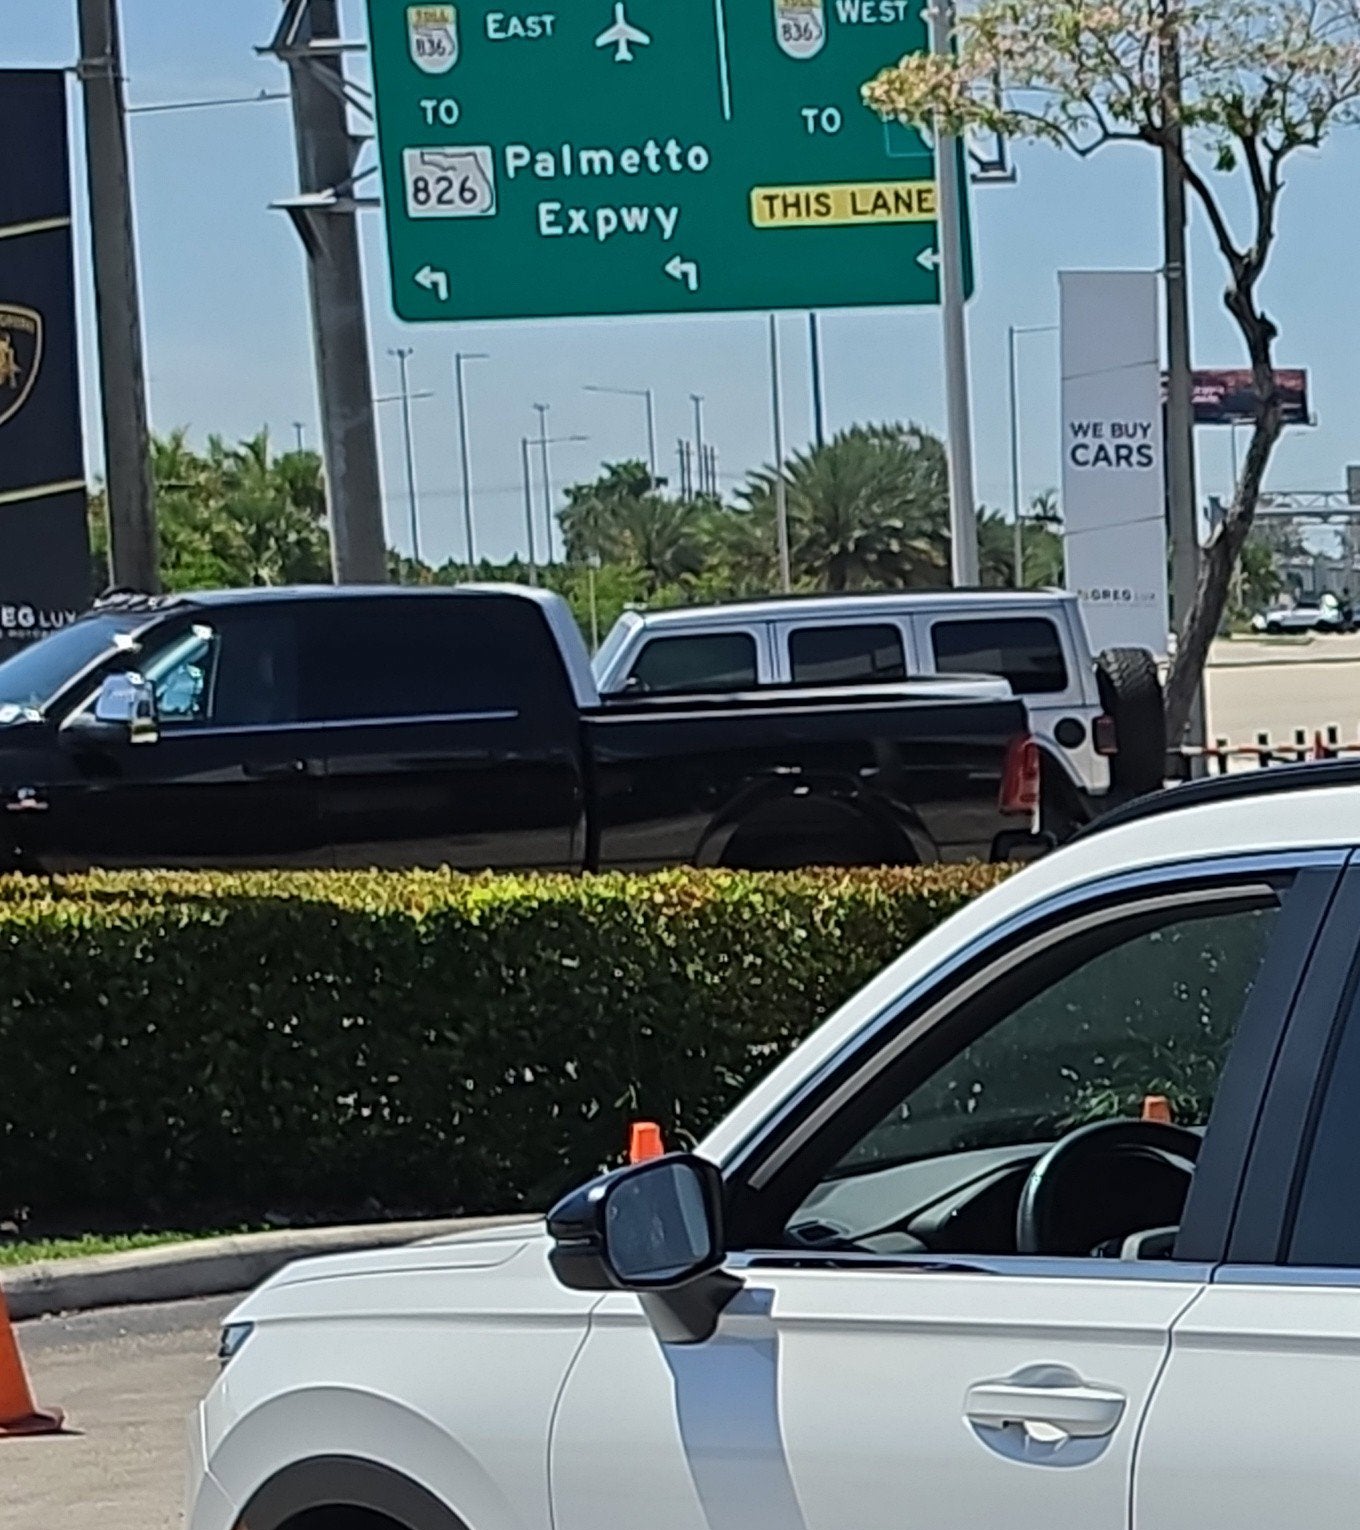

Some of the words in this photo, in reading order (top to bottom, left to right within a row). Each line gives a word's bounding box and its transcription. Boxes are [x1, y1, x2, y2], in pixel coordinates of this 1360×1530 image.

[836, 0, 908, 23] WEST
[486, 13, 555, 39] EAST
[782, 22, 813, 41] 836
[420, 99, 459, 125] TO
[801, 107, 841, 134] TO
[505, 138, 709, 178] Palmetto
[412, 175, 477, 205] 826
[762, 193, 831, 219] THIS
[850, 188, 935, 215] LANE
[538, 201, 678, 241] Expwy
[1070, 422, 1103, 438] WE
[1111, 422, 1151, 438] BUY
[1070, 443, 1153, 467] CARS
